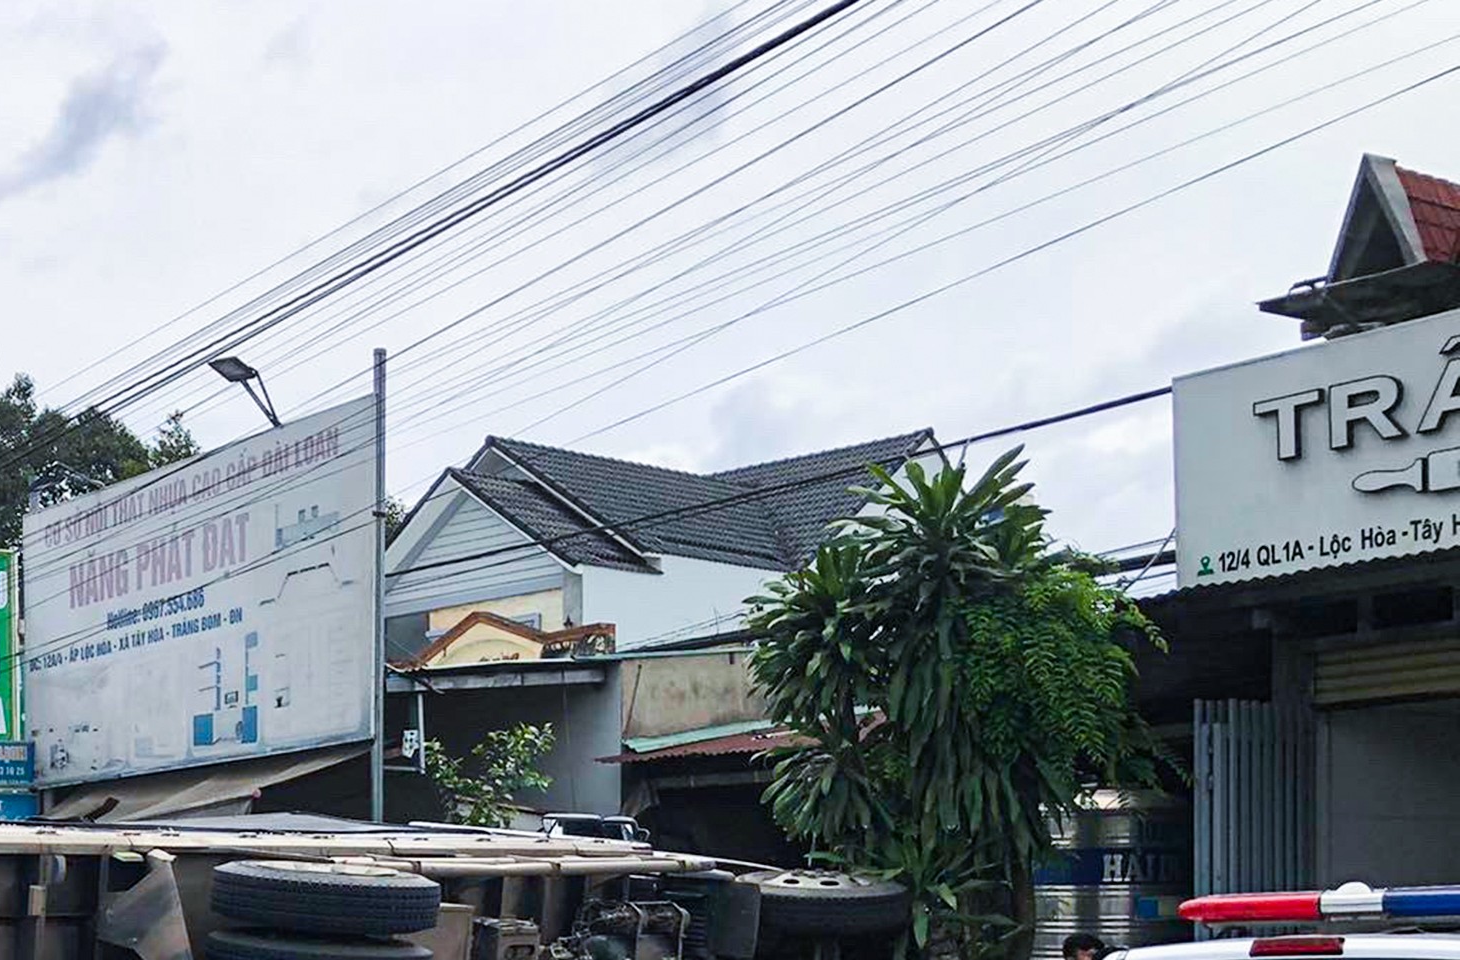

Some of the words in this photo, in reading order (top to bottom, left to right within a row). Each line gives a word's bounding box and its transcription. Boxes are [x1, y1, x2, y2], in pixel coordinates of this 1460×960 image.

[1218, 548, 1251, 573] 12/4
[1256, 540, 1304, 567] QL1A
[1319, 534, 1352, 559] Lộc
[1361, 527, 1396, 550] Hòa
